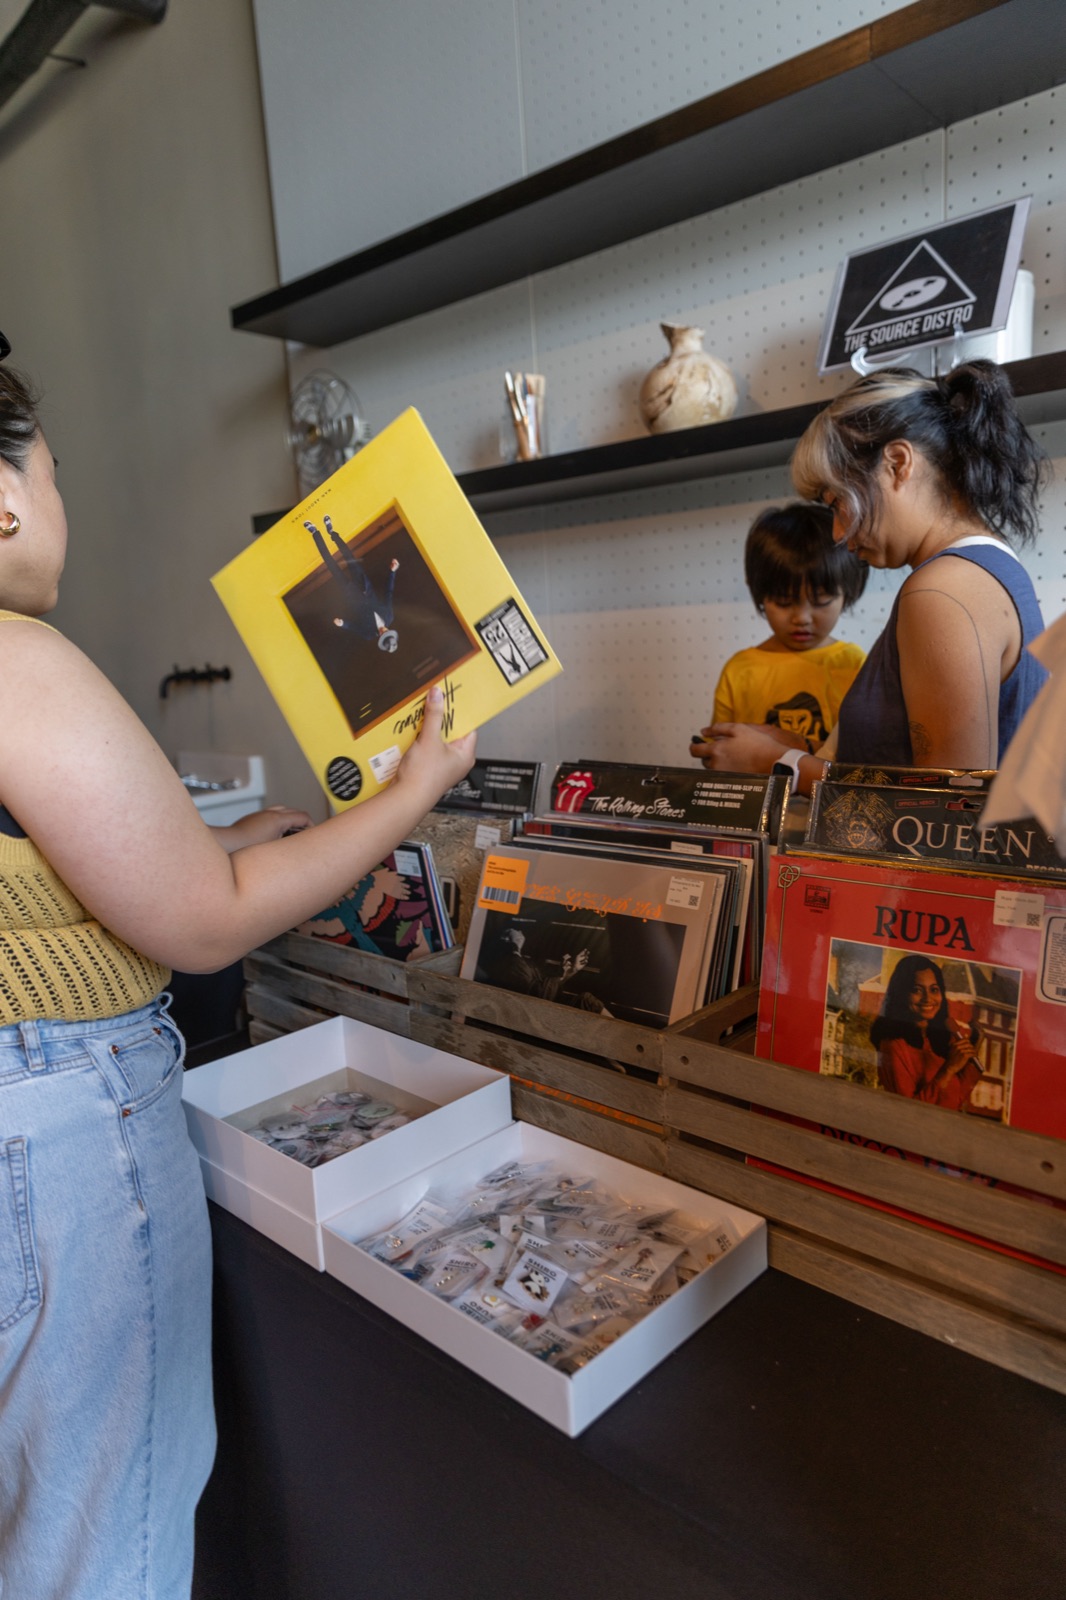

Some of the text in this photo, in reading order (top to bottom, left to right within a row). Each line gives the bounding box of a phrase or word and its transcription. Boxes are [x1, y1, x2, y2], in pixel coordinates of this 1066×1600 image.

[844, 331, 868, 353] THE
[869, 318, 922, 347] SOURCE
[922, 304, 974, 332] DISTRO
[588, 796, 686, 820] The Rolling Stones
[892, 815, 1036, 858] QUEEN
[872, 905, 976, 952] RUPA
[449, 1259, 478, 1268] SHIRO
[528, 1258, 557, 1277] SHIRO
[523, 1265, 550, 1283] KUO
[460, 1305, 486, 1324] SHIRO
[470, 1301, 496, 1320] KURO
